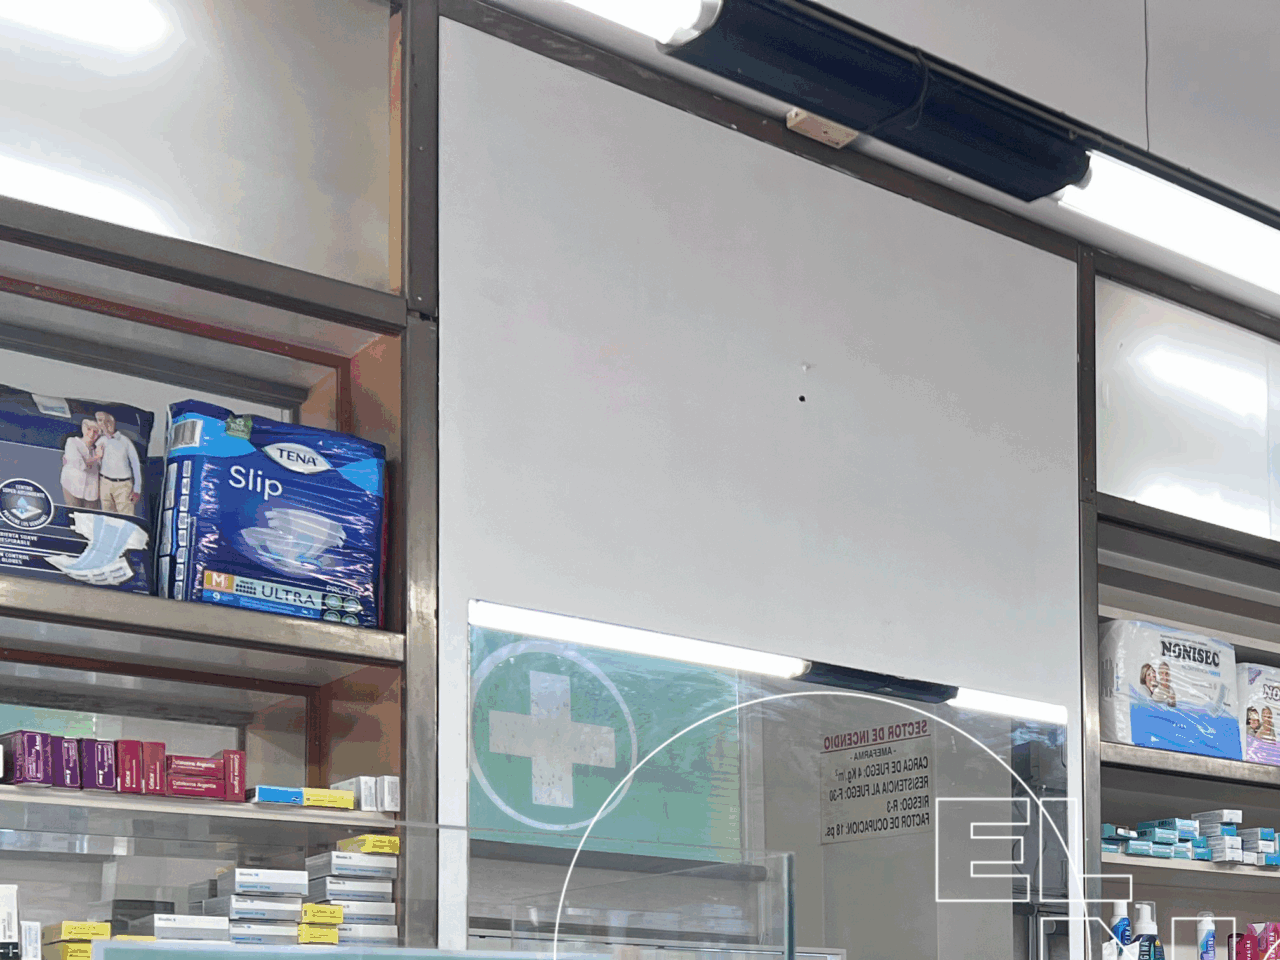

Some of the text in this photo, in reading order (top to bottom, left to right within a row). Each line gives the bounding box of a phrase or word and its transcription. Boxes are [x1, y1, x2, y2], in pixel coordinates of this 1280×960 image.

[276, 447, 317, 467] TENA
[228, 465, 283, 500] Slip
[211, 572, 225, 588] M
[261, 584, 316, 606] ULTRA
[1161, 641, 1220, 667] NONISEC
